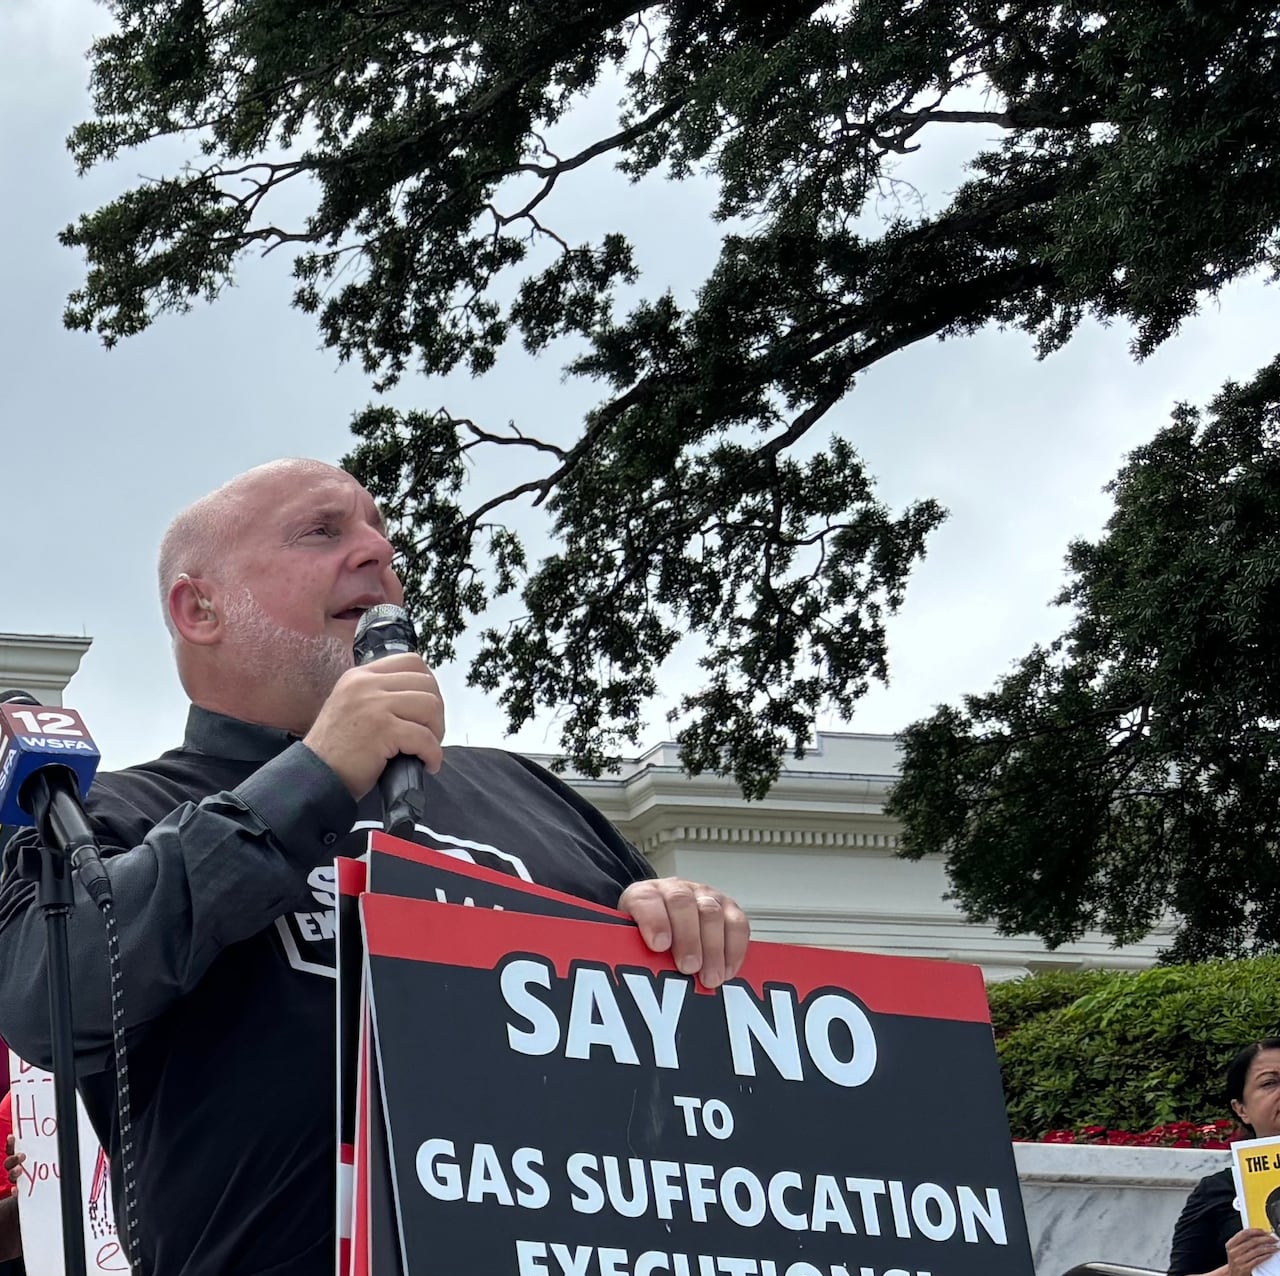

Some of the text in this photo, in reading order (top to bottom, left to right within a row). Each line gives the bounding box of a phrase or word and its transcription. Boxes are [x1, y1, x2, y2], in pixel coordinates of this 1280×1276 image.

[11, 711, 83, 737] 12
[21, 736, 93, 751] WSFA
[498, 959, 878, 1088] SAY NO
[673, 1096, 734, 1140] TO
[1245, 1155, 1270, 1173] THE
[415, 1138, 1009, 1247] GAS SUFFOCATION
